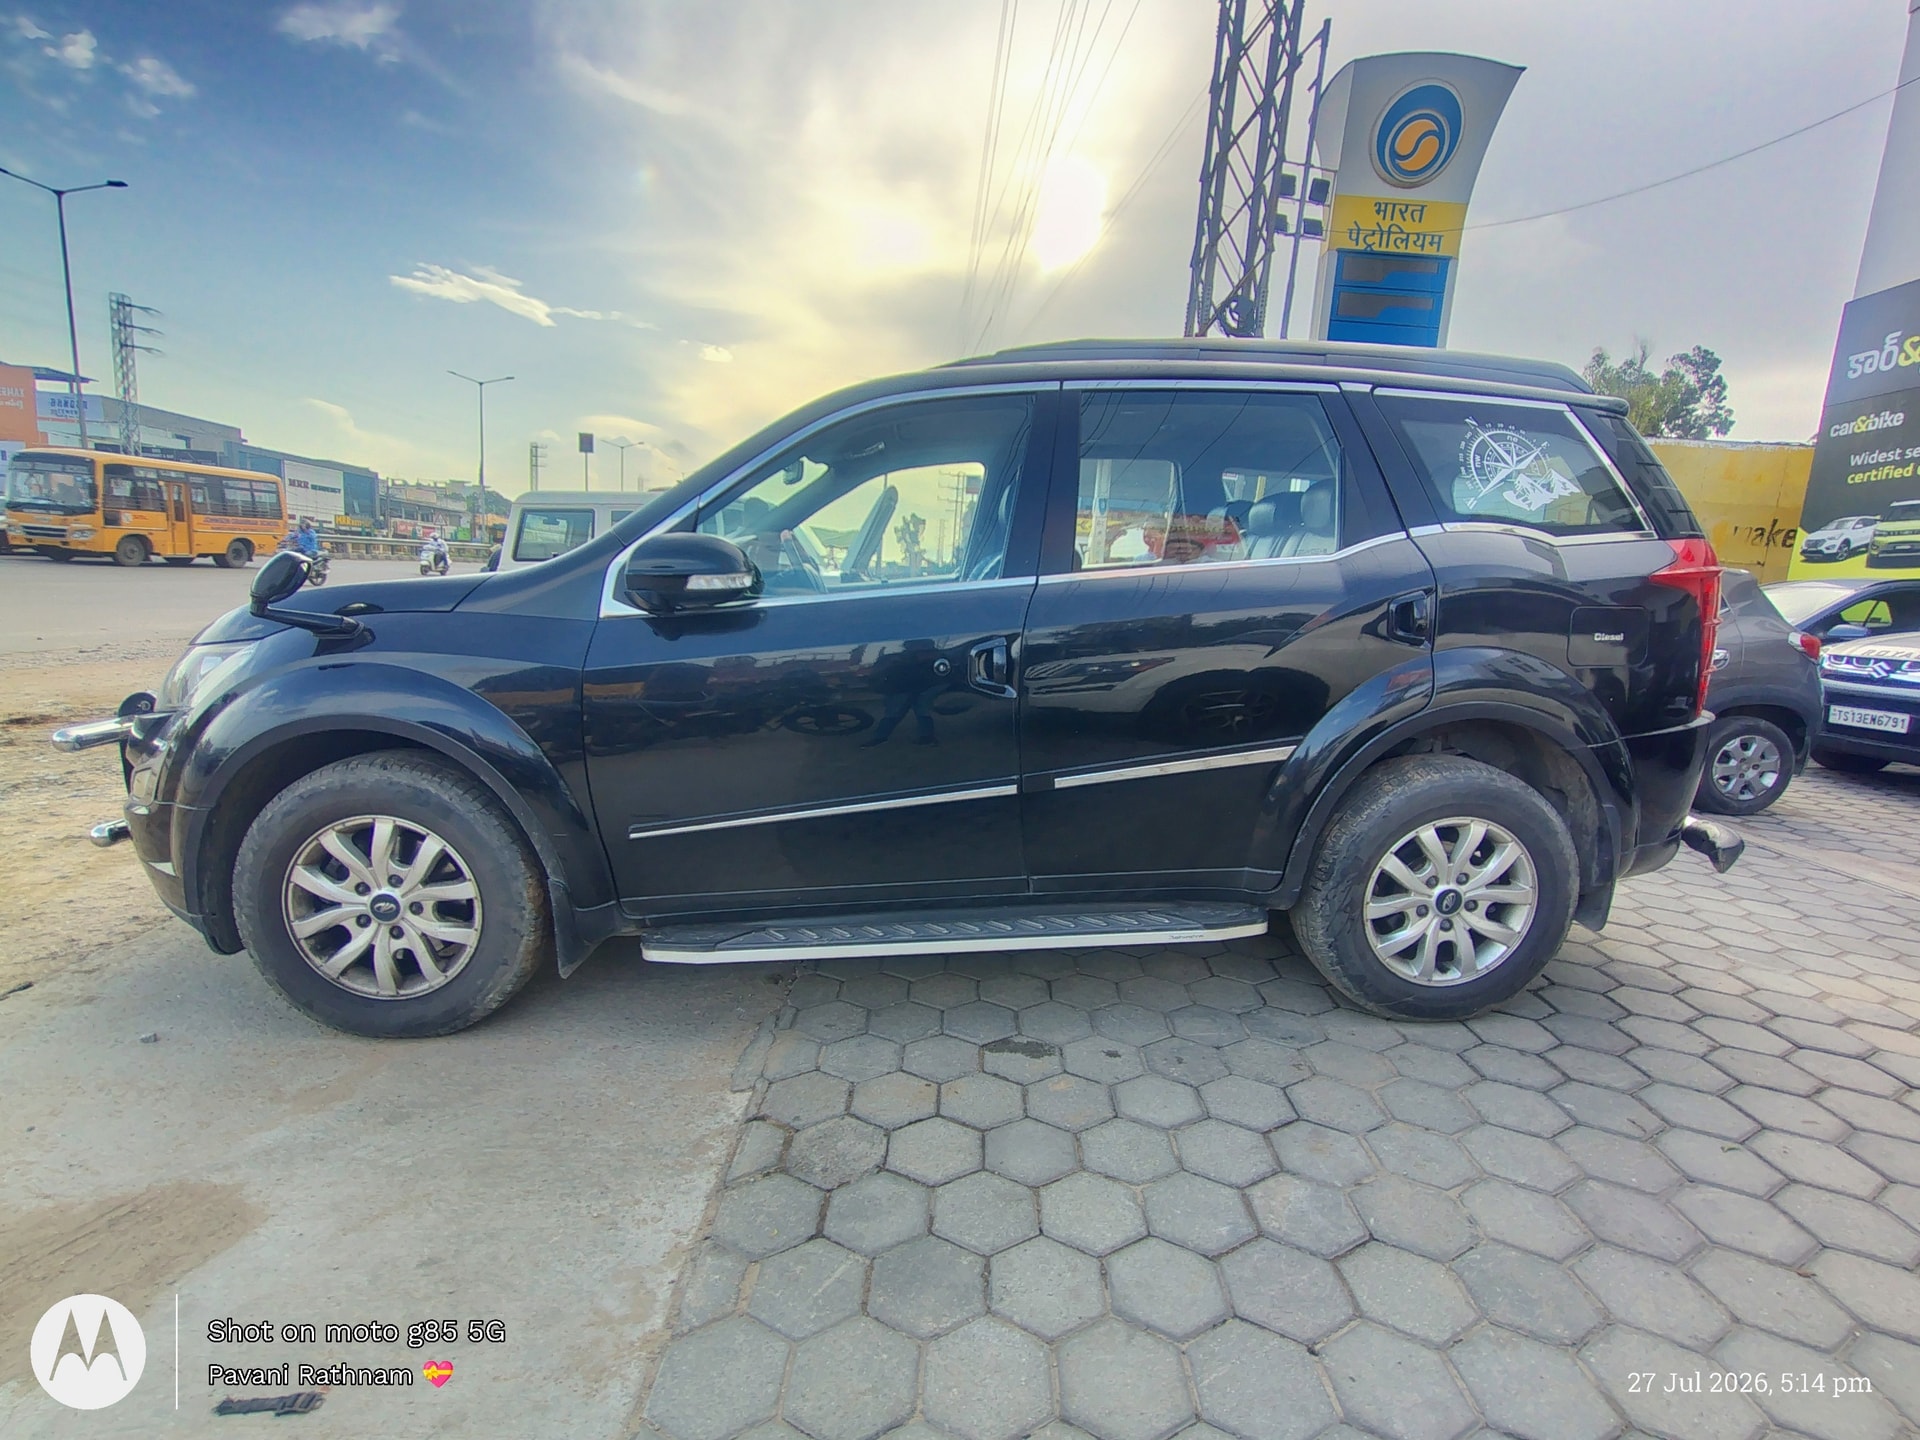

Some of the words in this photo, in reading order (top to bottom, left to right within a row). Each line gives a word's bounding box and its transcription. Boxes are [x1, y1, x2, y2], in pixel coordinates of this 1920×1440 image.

[1374, 202, 1428, 223] भारत
[1347, 220, 1444, 252] पेट्रोलियम
[1829, 411, 1904, 438] car&bike
[1850, 448, 1902, 467] Widest
[1847, 463, 1914, 485] certified
